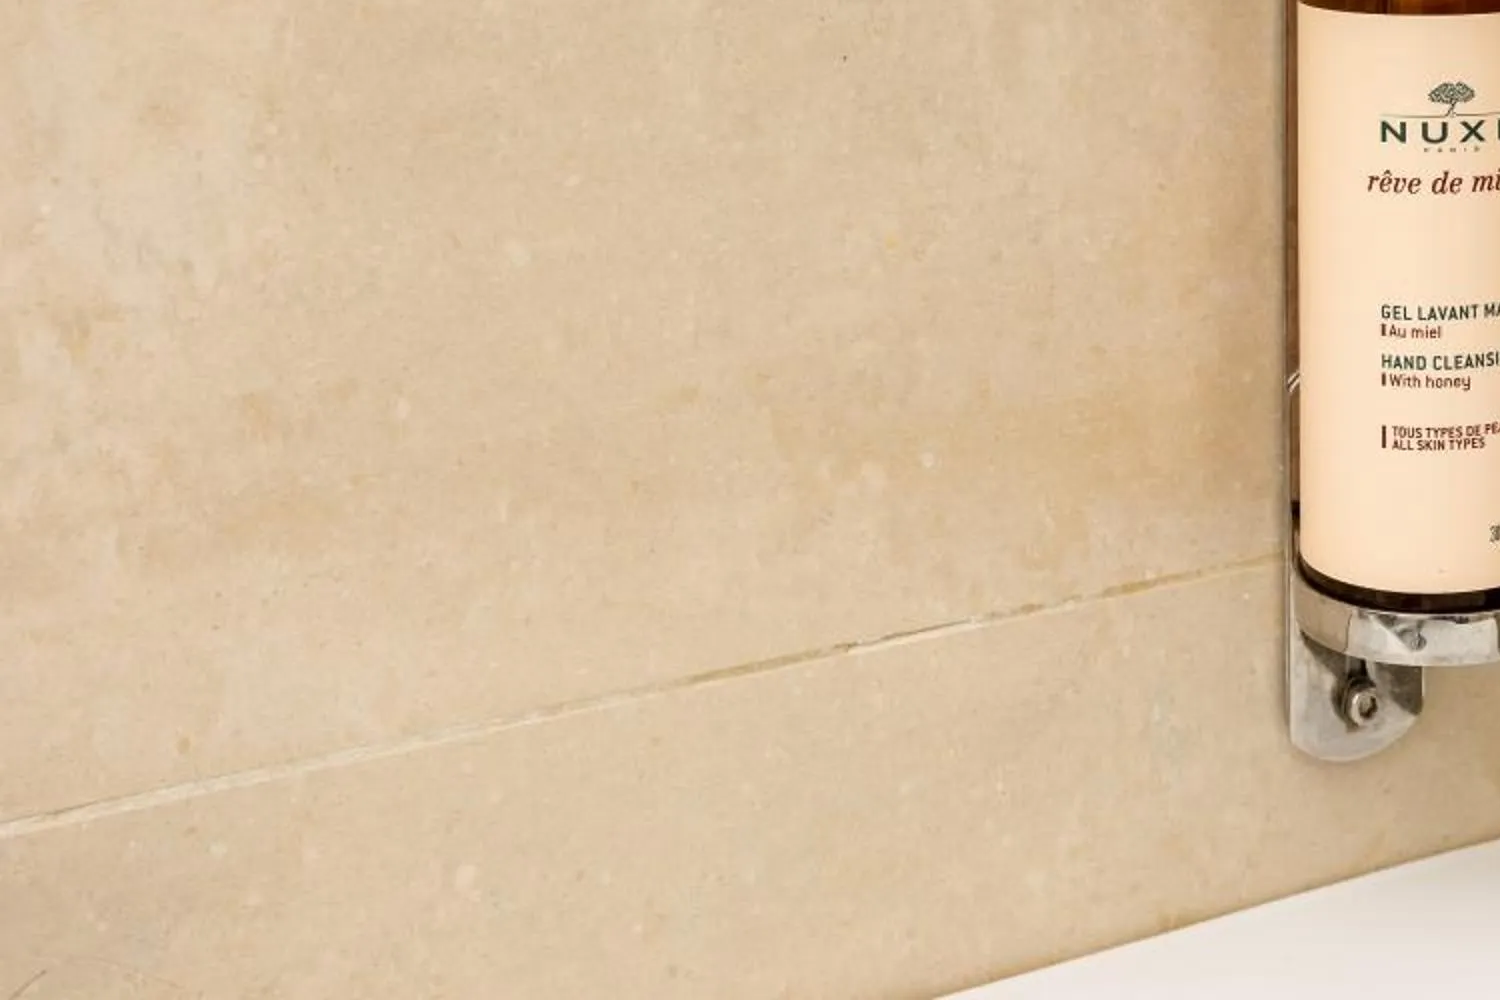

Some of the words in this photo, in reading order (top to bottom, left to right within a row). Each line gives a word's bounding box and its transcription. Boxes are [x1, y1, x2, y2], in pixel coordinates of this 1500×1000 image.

[1367, 169, 1421, 194] rêve
[1432, 171, 1462, 194] de
[1381, 305, 1413, 321] GEL
[1417, 304, 1480, 321] LAVANT
[1389, 324, 1407, 338] Au
[1411, 326, 1441, 339] miel
[1381, 353, 1427, 371] HAND
[1389, 374, 1421, 389] With
[1425, 376, 1471, 391] honey
[1392, 426, 1423, 439] TOUS
[1426, 426, 1463, 439] TYPES
[1466, 424, 1481, 437] DE
[1392, 439, 1415, 451] ALL
[1417, 439, 1445, 451] SKIN
[1449, 436, 1486, 451] TYPES
